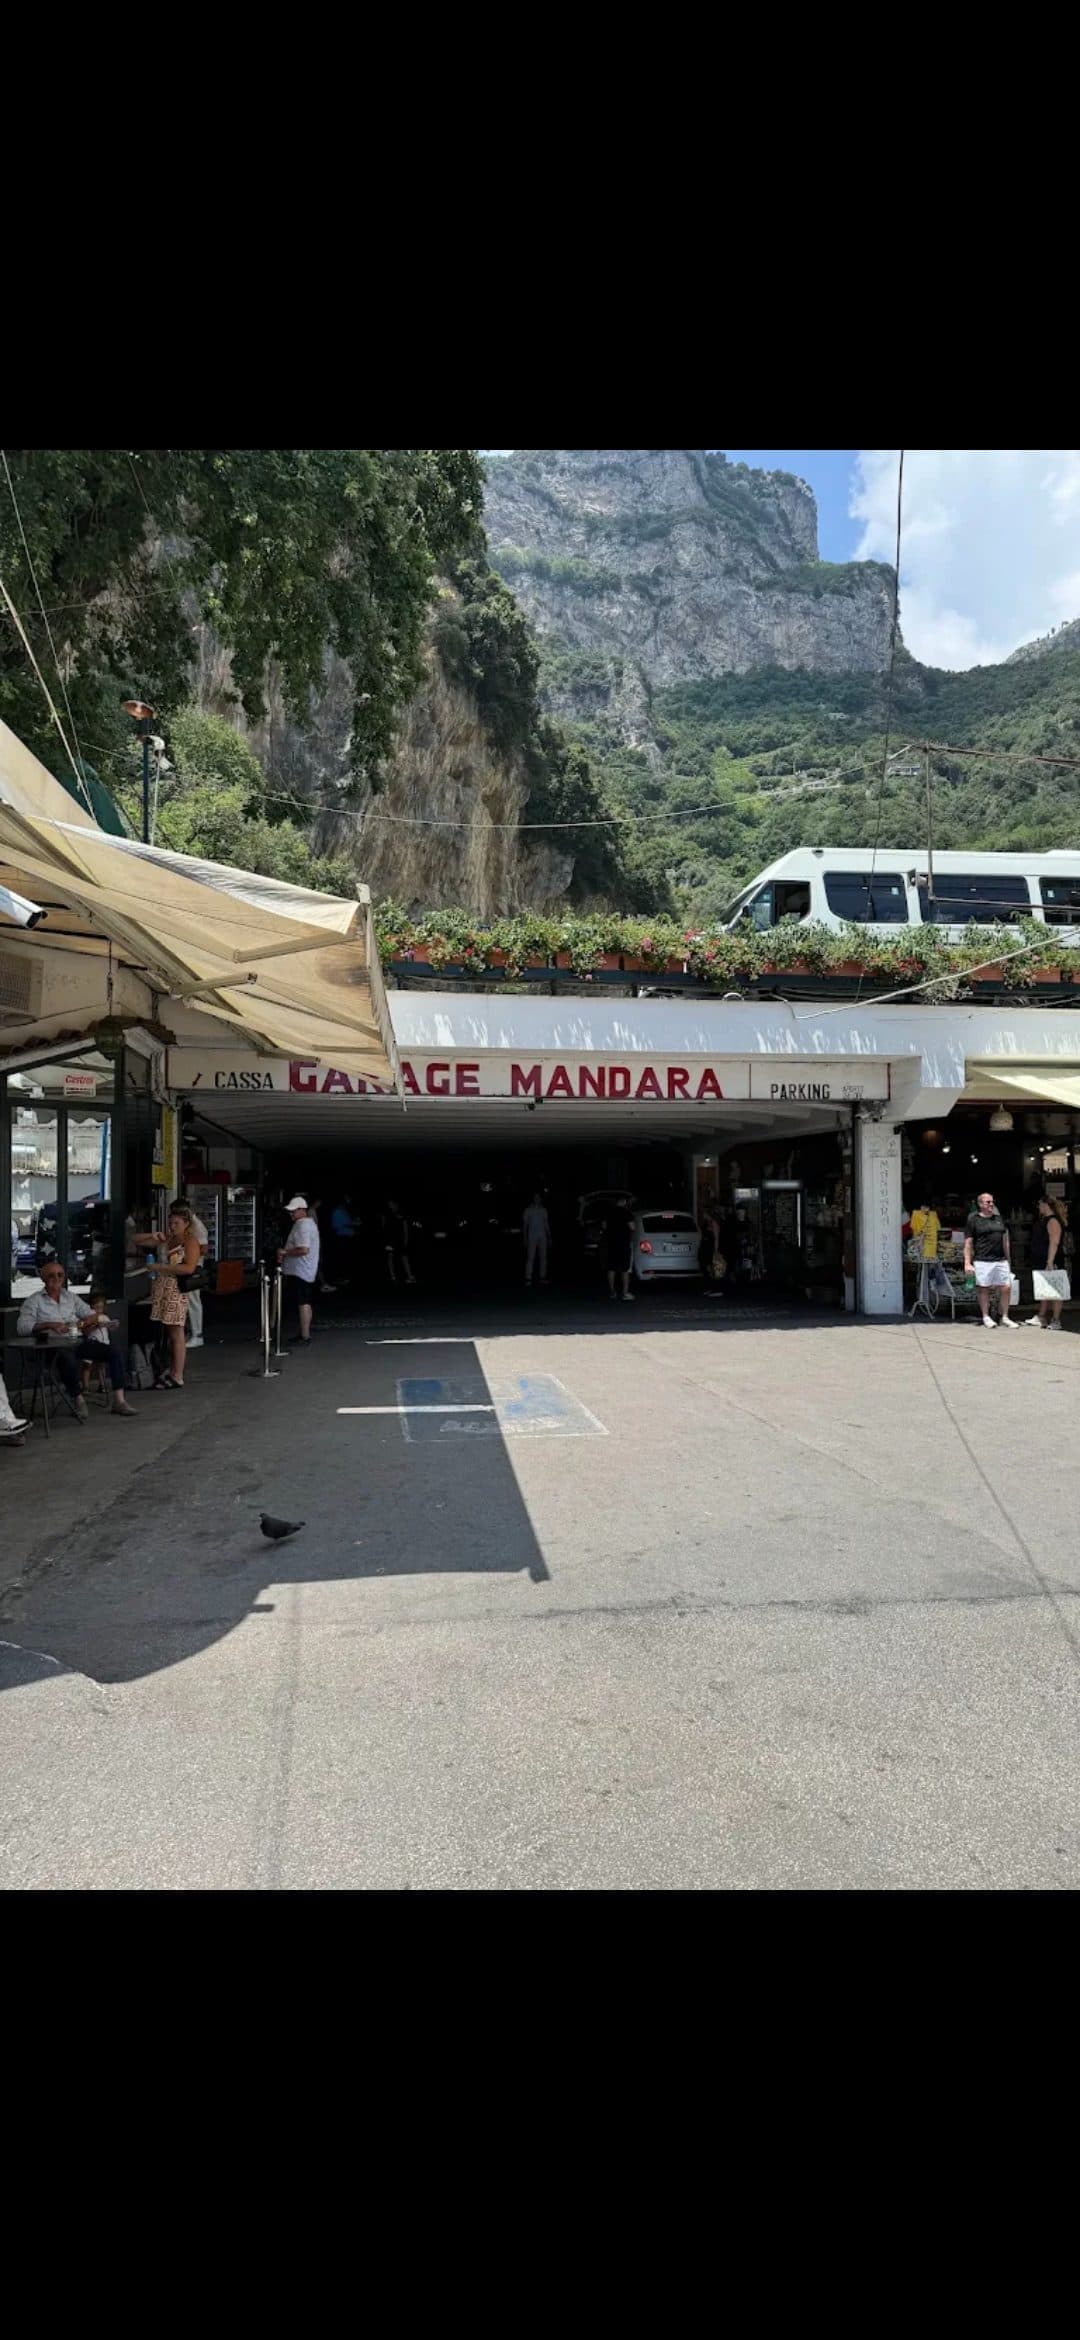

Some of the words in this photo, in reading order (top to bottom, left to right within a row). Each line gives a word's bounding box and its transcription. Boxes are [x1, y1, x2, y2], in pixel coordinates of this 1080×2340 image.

[214, 1070, 274, 1089] CASSA
[511, 1063, 724, 1099] MANDARA
[770, 1083, 831, 1100] PARKING
